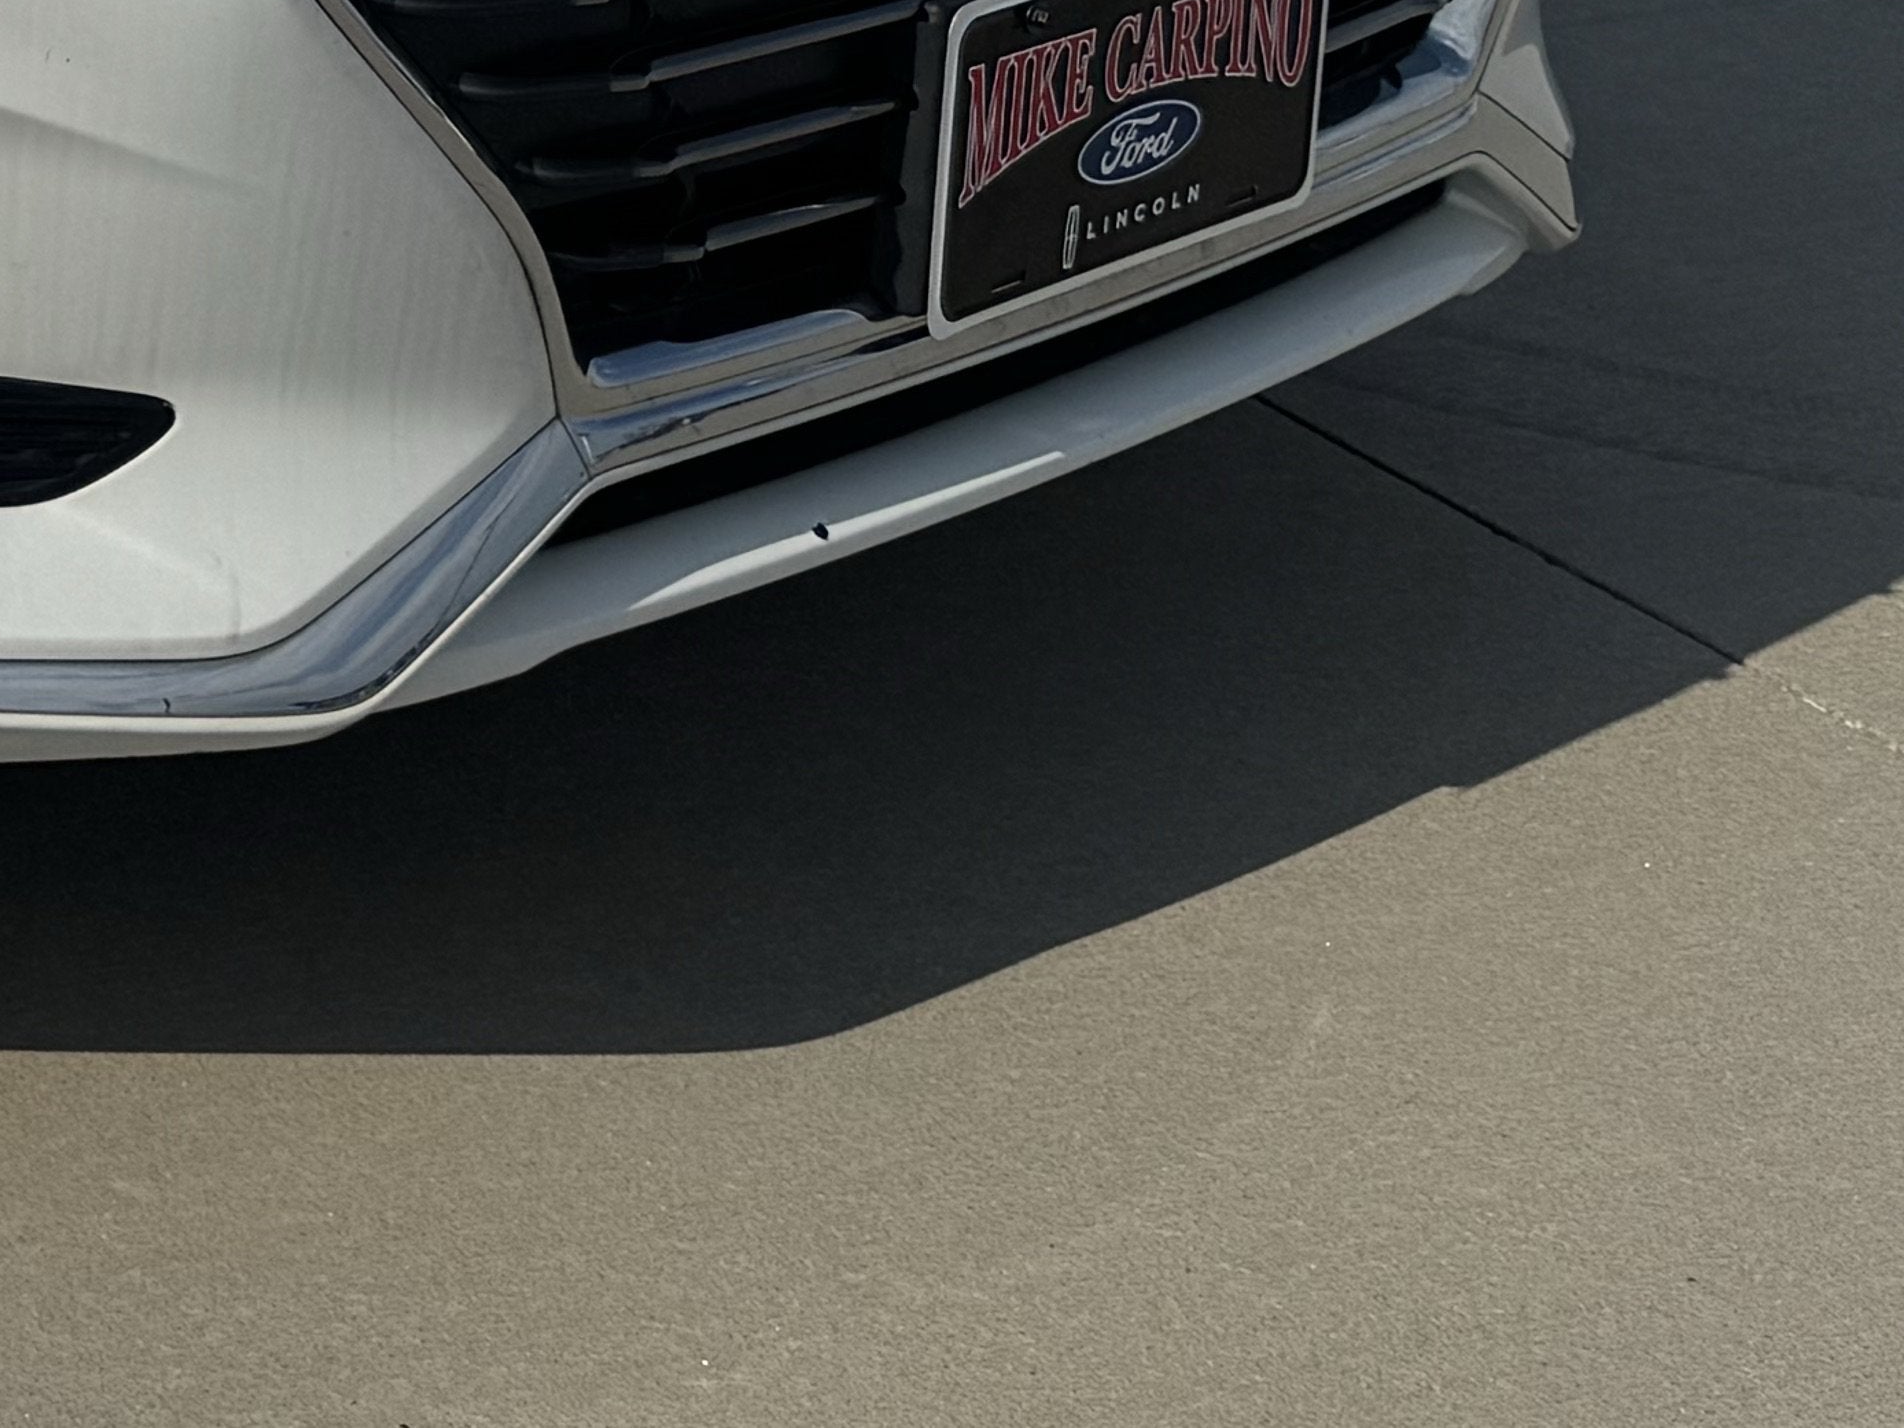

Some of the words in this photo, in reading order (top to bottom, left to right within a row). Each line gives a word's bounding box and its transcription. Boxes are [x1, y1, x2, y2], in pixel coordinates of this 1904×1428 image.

[958, 28, 1097, 209] MIKE
[1100, 111, 1174, 175] Ford
[1086, 183, 1201, 240] LINCOLN
